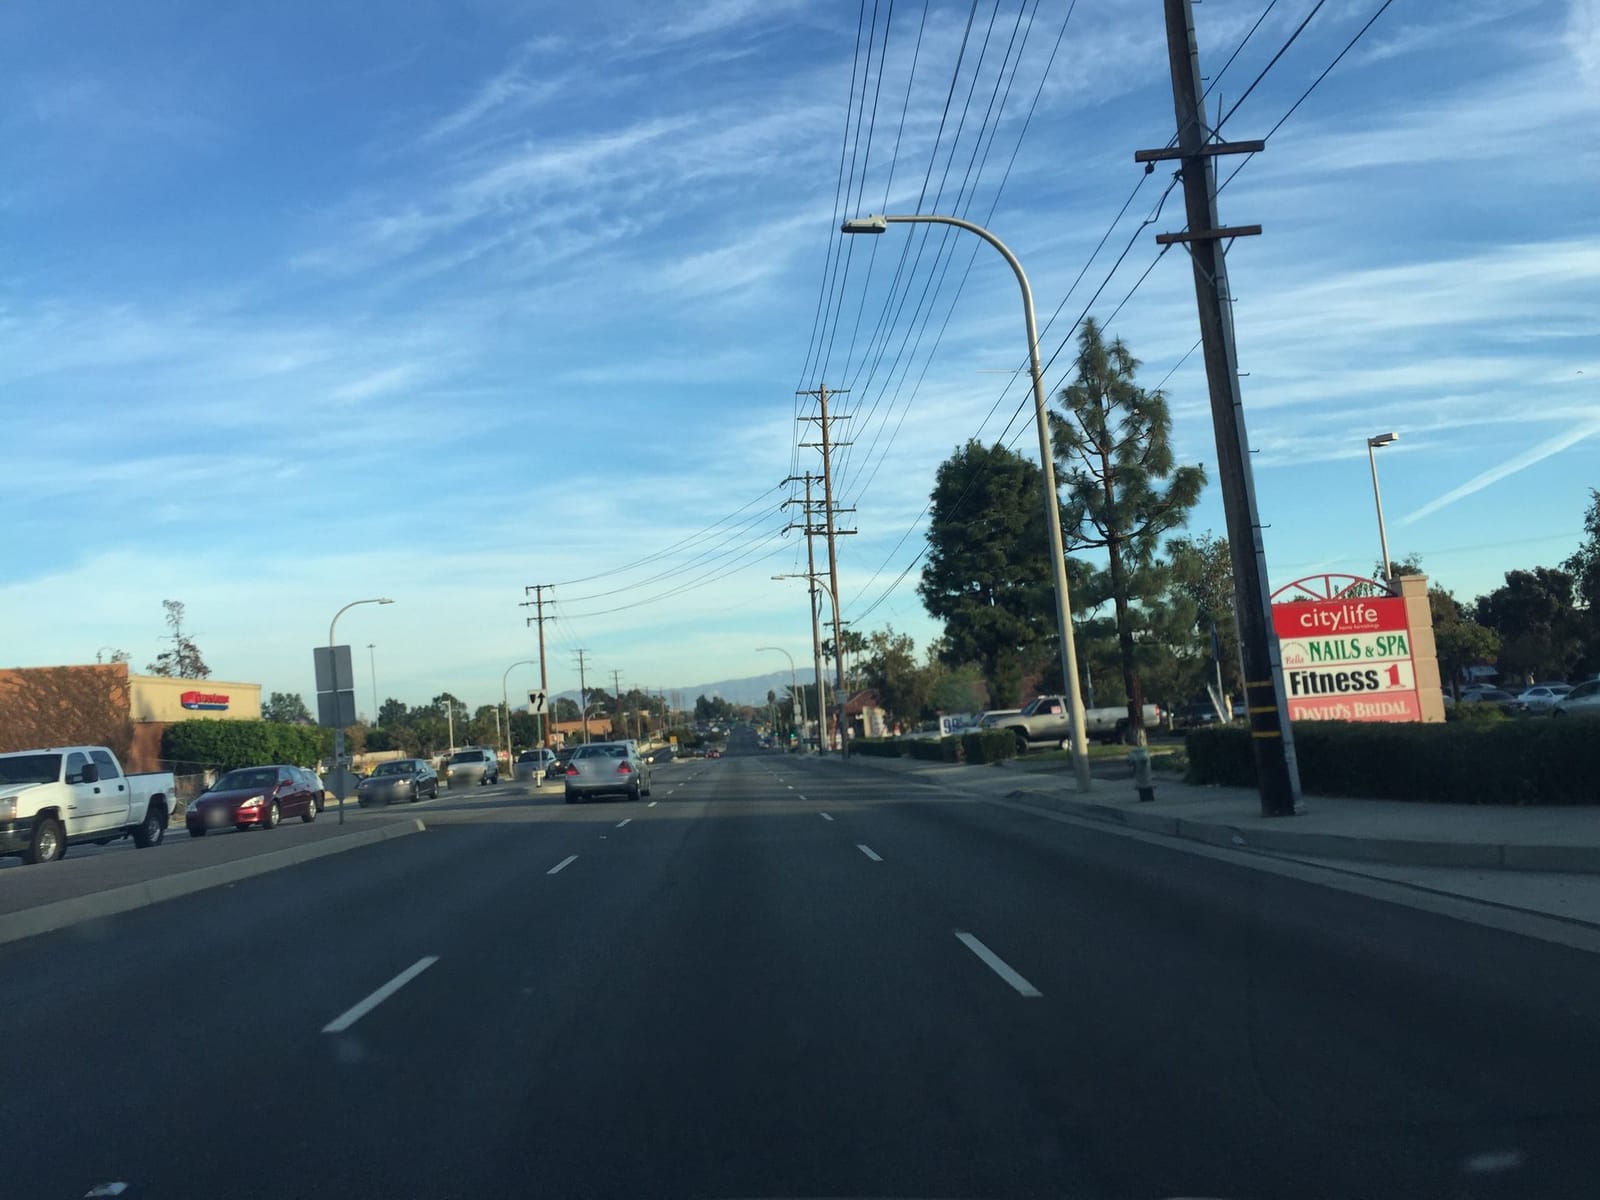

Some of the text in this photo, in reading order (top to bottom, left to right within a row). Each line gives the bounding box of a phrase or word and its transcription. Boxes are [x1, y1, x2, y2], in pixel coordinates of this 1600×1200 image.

[1300, 603, 1378, 631] citylife
[1308, 638, 1361, 662] NAILS
[1366, 646, 1374, 658] &
[1376, 634, 1408, 657] SPA
[1289, 663, 1402, 696] Fitness 1
[1354, 701, 1409, 718] BRIDAL
